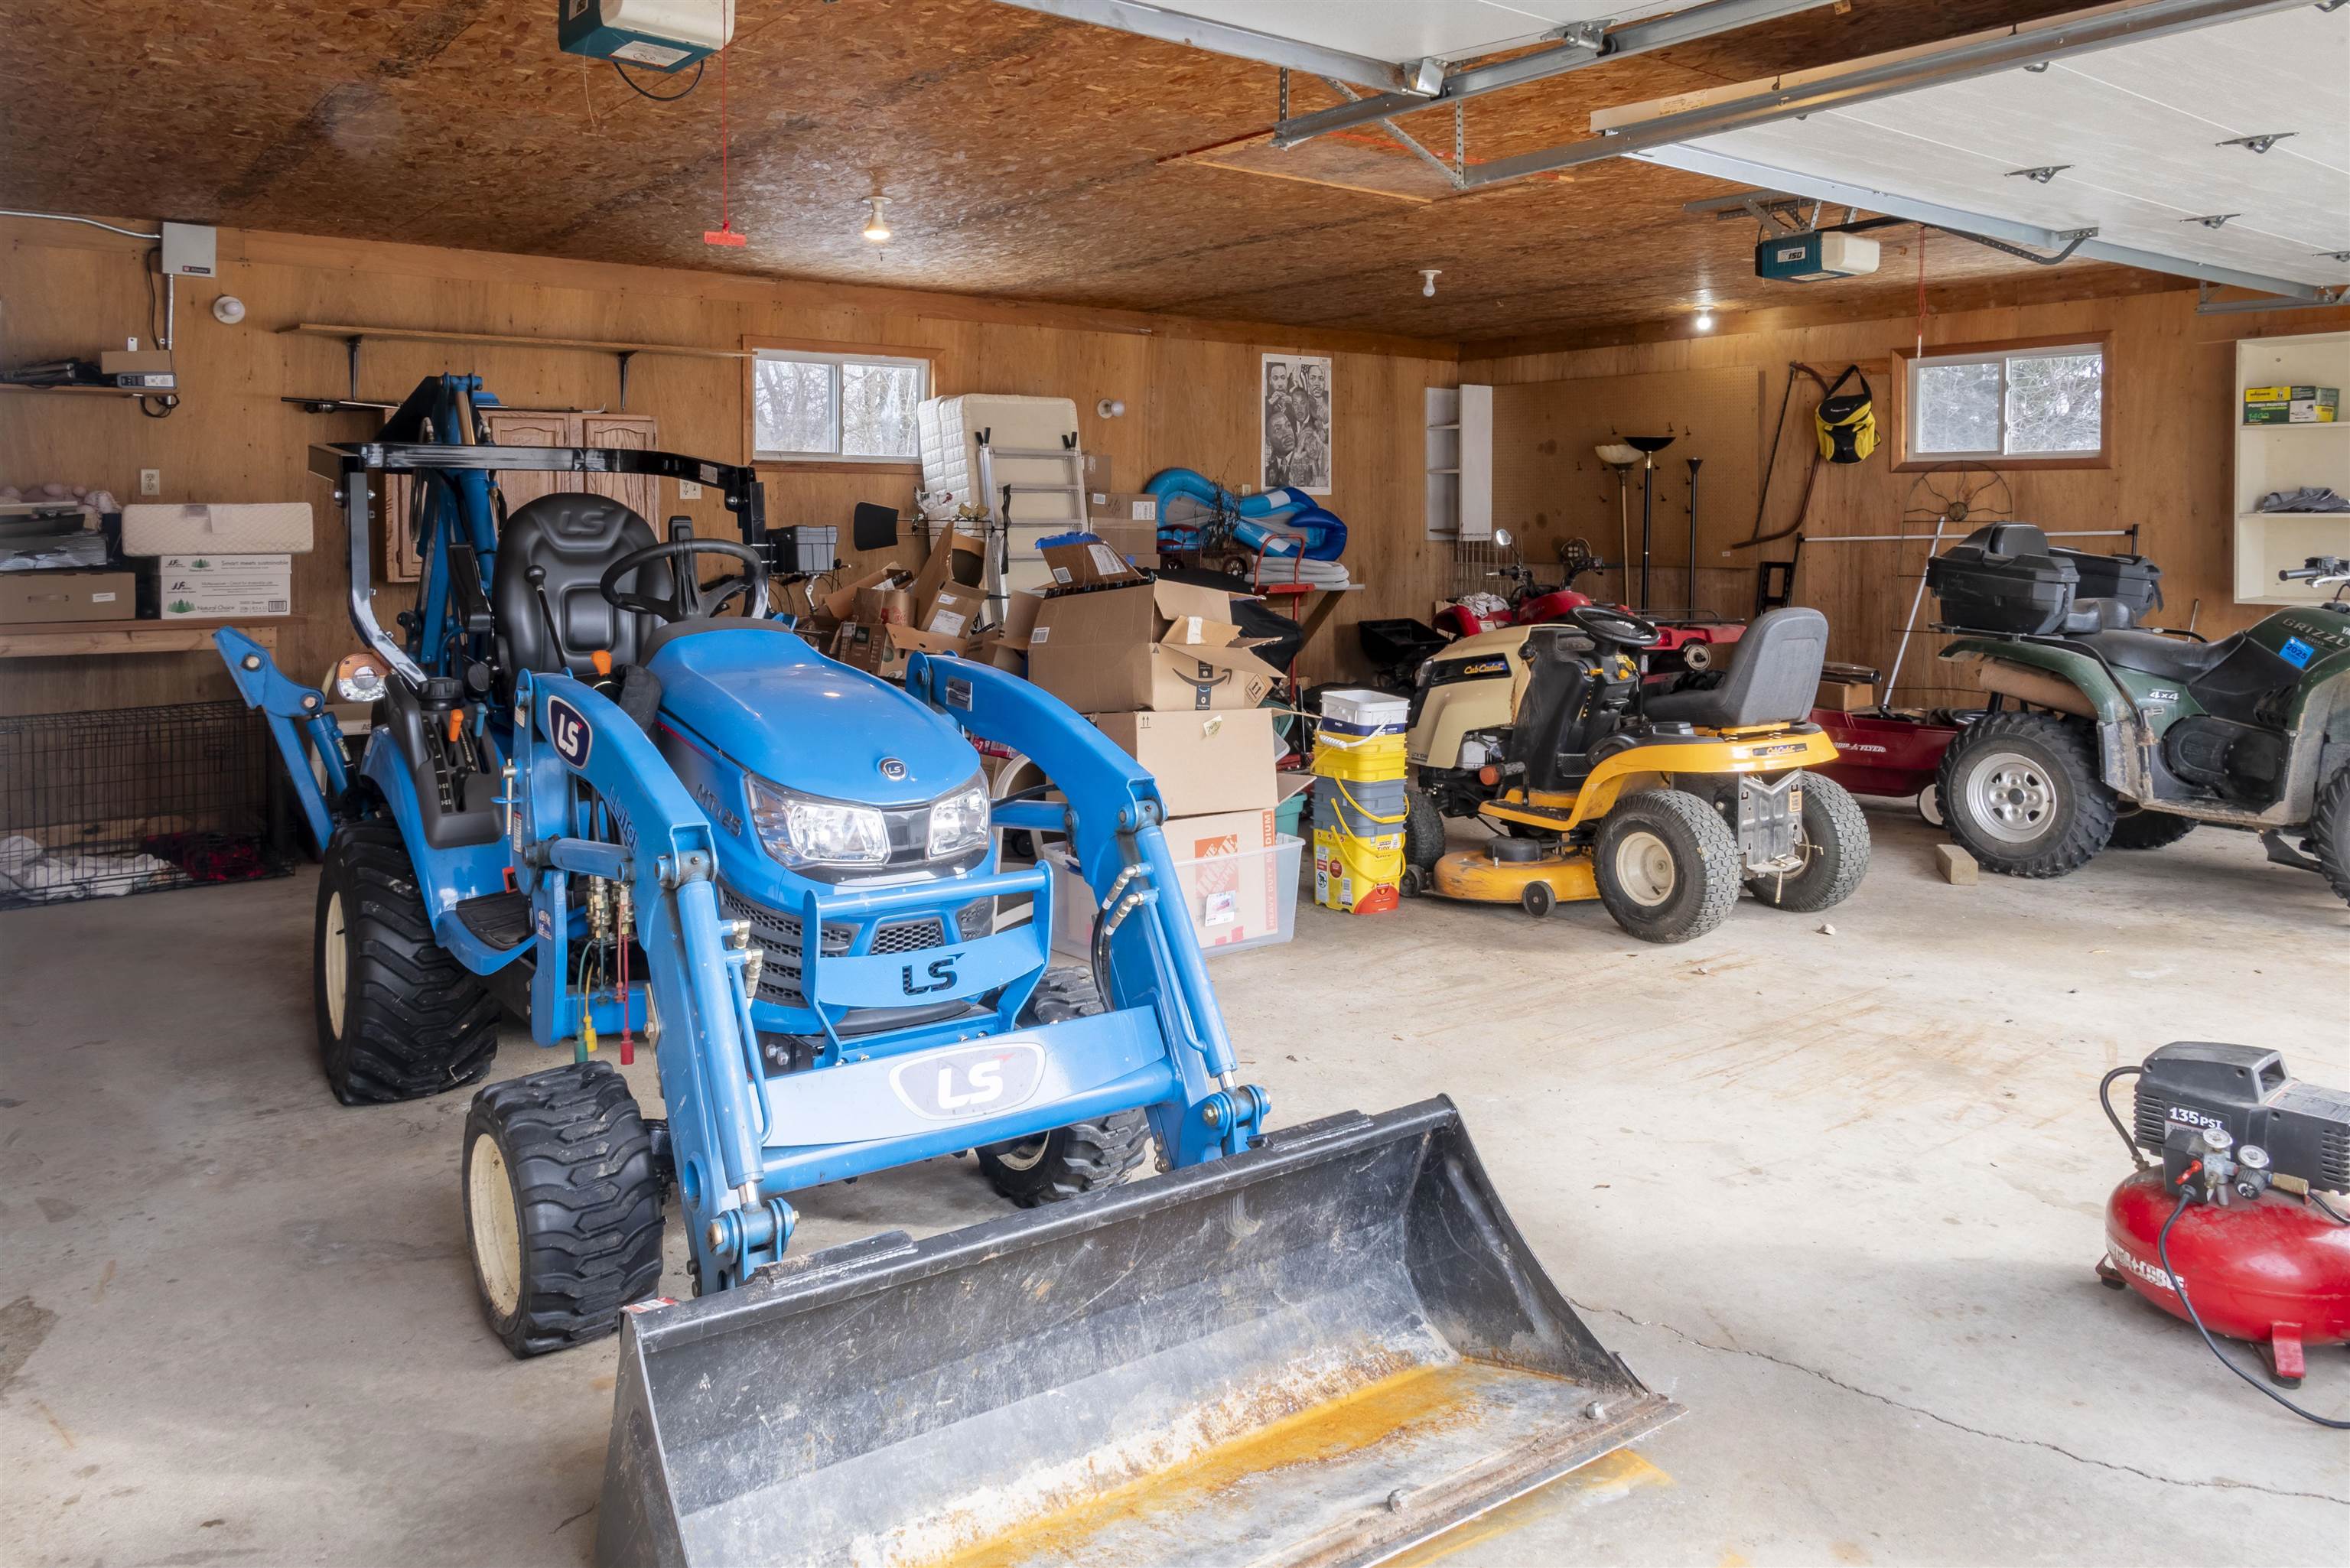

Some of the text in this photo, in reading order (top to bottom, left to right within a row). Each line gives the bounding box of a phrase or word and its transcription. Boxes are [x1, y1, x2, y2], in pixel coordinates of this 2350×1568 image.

[1788, 251, 1803, 260] 150
[558, 510, 607, 535] LS
[2282, 618, 2347, 647] GRIZZL
[2286, 643, 2308, 659] 2025
[1463, 662, 1505, 675] Cub Cadet
[558, 713, 580, 757] LS
[888, 765, 902, 774] LS
[902, 958, 958, 996] LS
[937, 1059, 1004, 1109] LS
